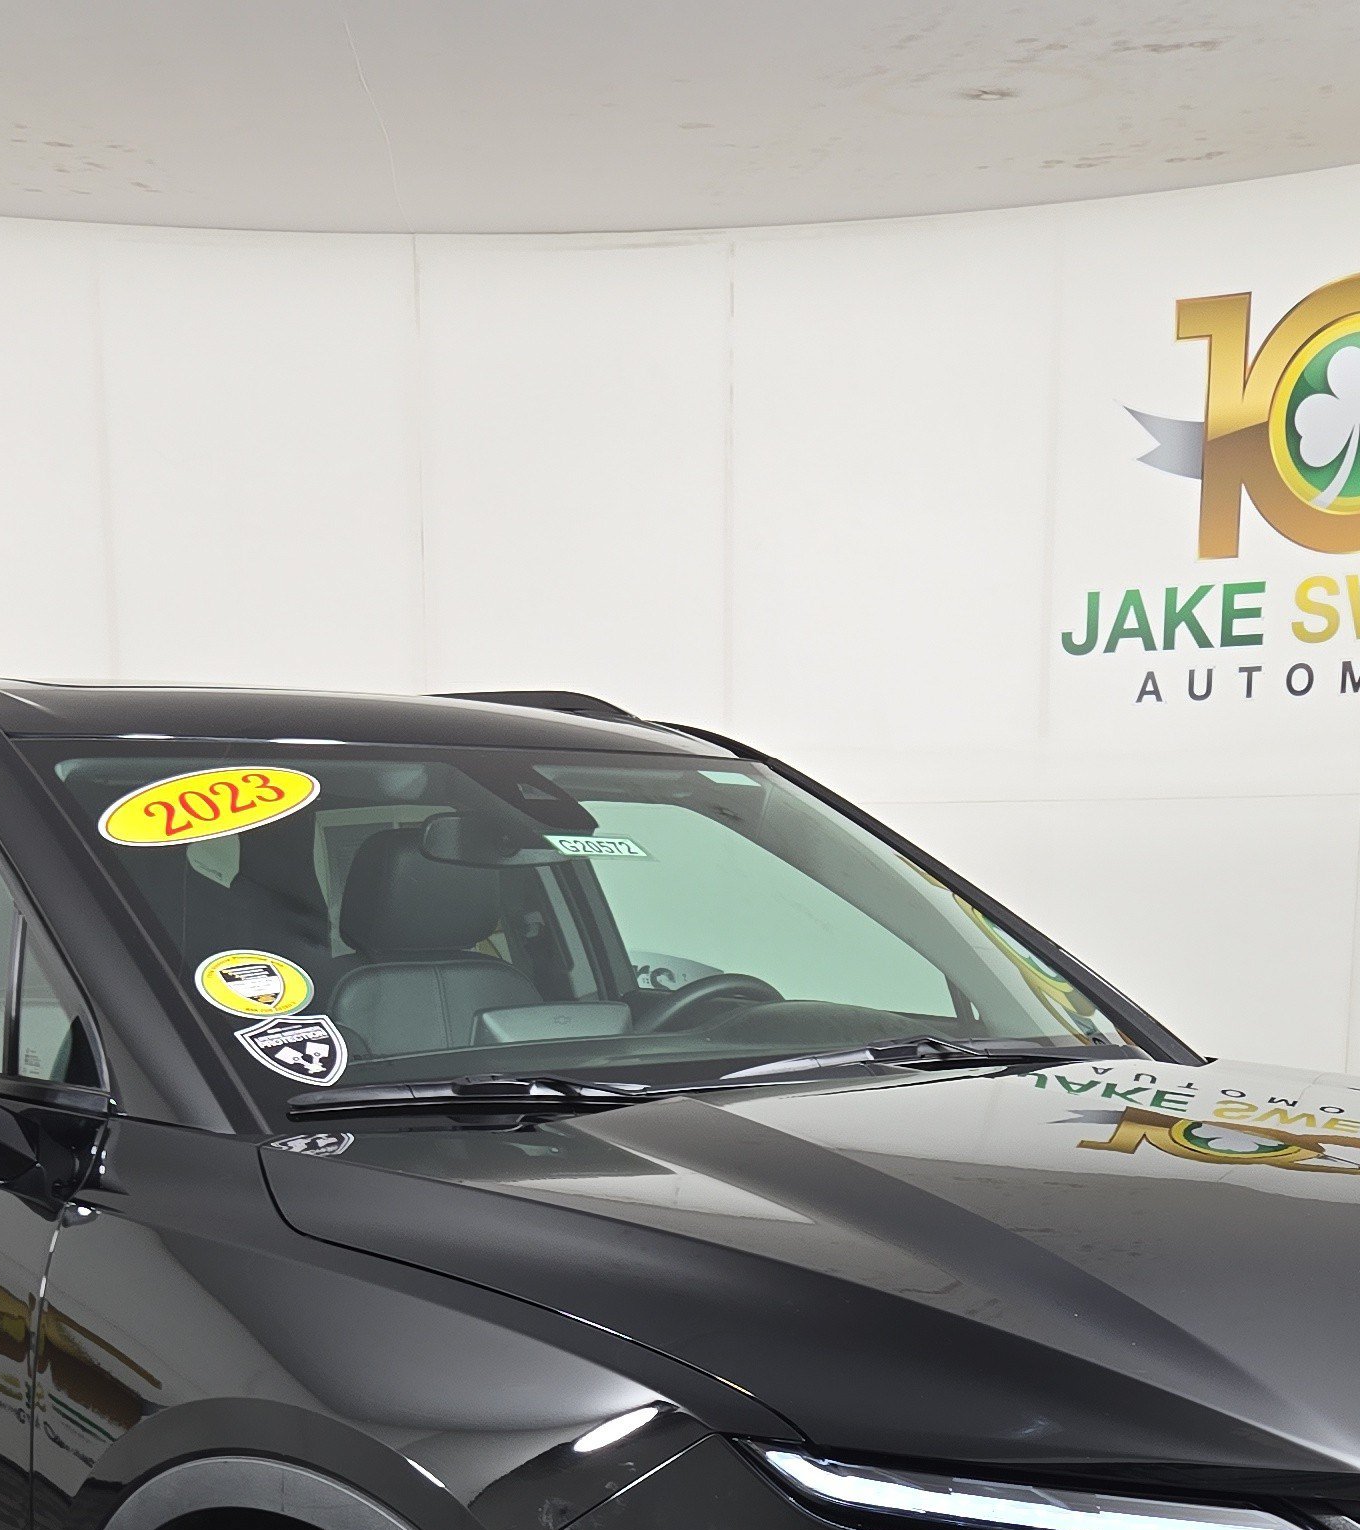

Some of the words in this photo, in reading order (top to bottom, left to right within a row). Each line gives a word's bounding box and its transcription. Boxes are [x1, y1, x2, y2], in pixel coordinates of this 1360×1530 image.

[1061, 581, 1266, 656] JAKE
[142, 772, 286, 838] 2023
[558, 839, 639, 855] G20572
